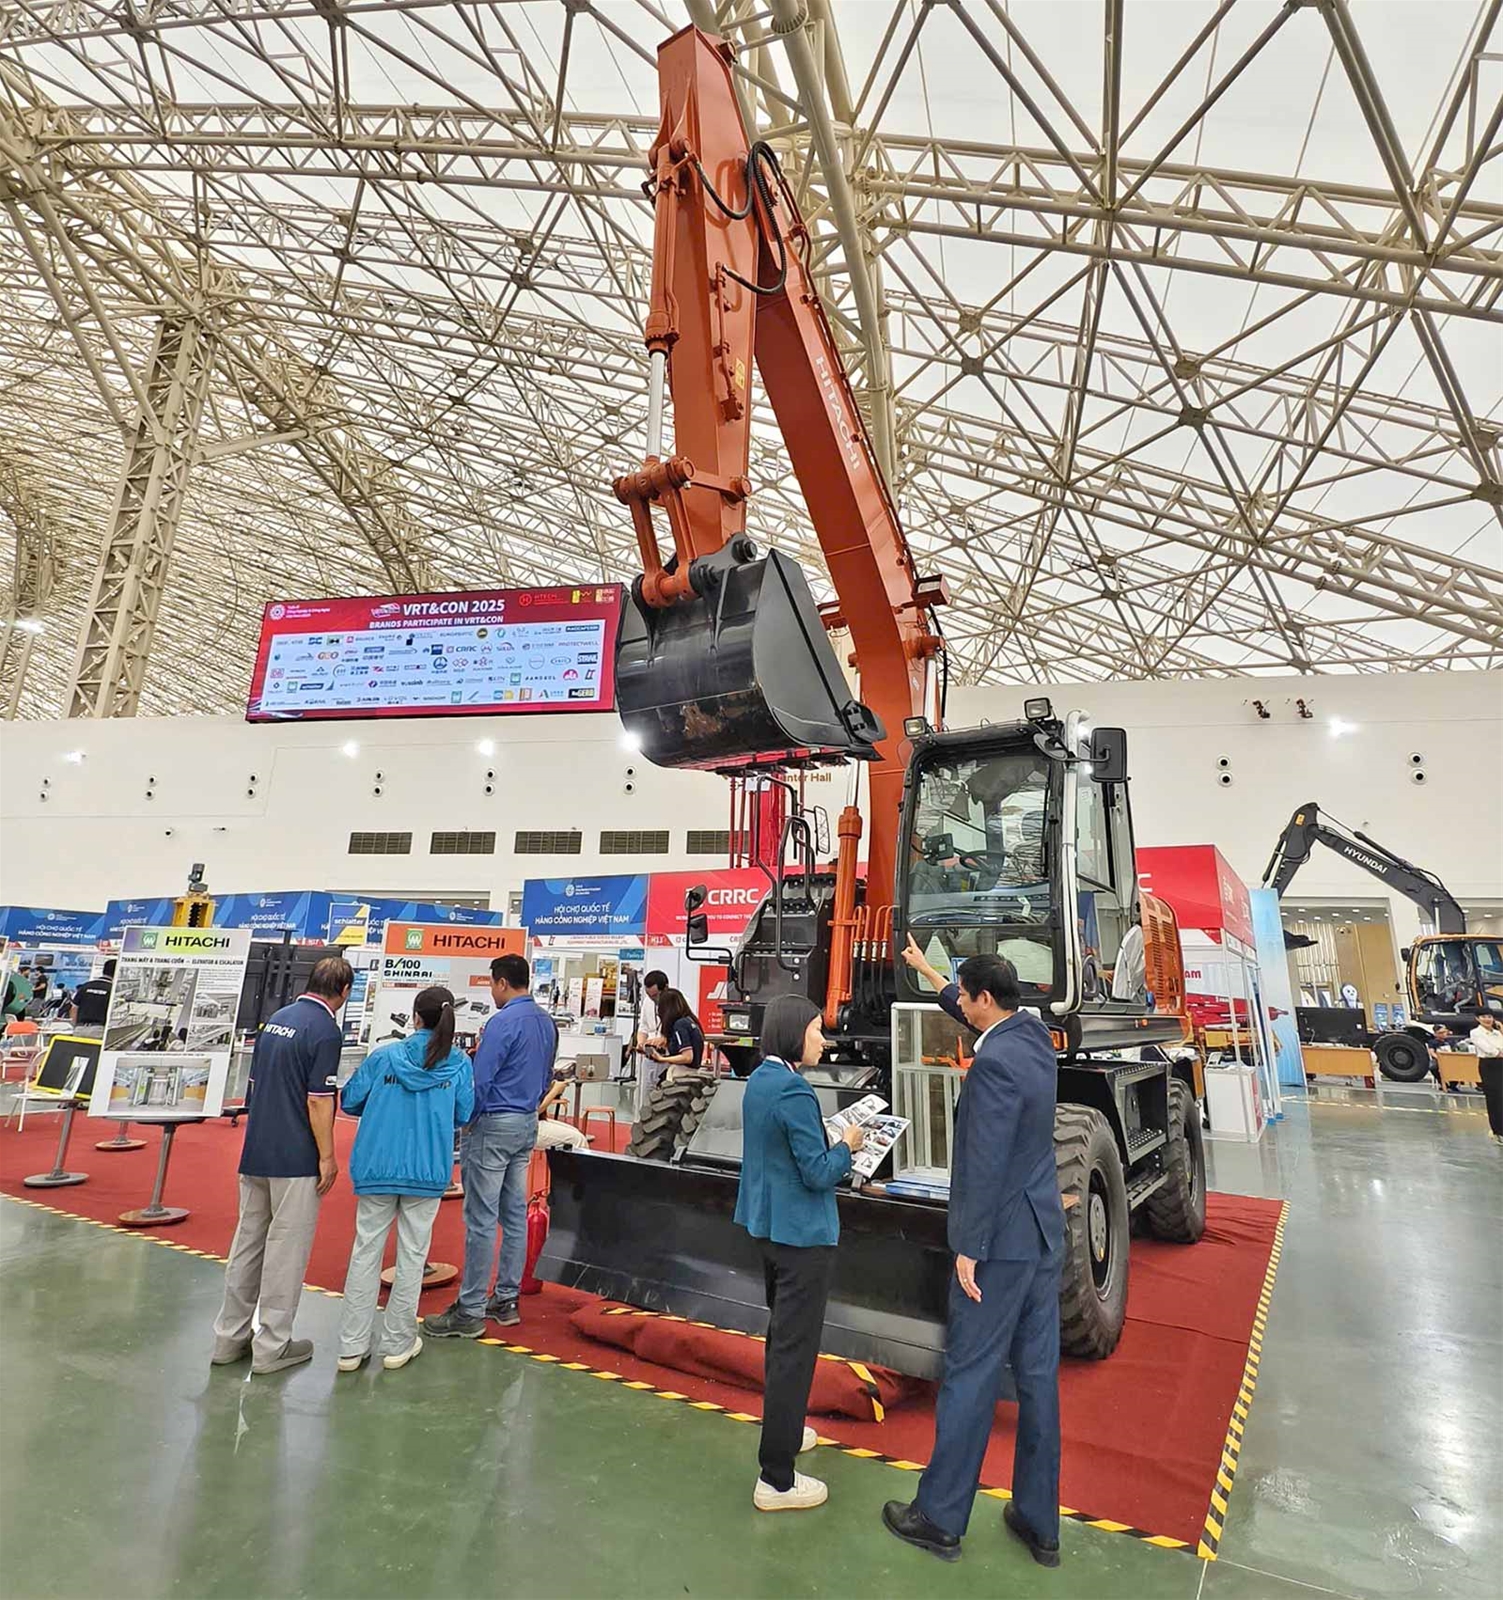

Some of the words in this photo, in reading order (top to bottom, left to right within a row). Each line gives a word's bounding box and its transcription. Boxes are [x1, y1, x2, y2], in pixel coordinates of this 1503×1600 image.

[815, 356, 861, 470] HITACHI
[402, 601, 469, 617] VRT&CON
[471, 599, 506, 614] 2025
[369, 619, 402, 629] BRANDS
[403, 617, 453, 628] PARTICIPATE
[454, 616, 464, 625] IN
[464, 615, 504, 624] VRT&CON
[810, 773, 832, 782] Hall
[1343, 846, 1388, 874] HYUNDAI
[707, 888, 760, 905] CRRC
[334, 917, 364, 925] schlatter
[535, 915, 553, 925] HÀNG
[573, 914, 598, 926] NGHIỆP
[598, 914, 613, 926] VIỆT
[613, 914, 630, 923] NAM
[164, 936, 231, 948] HITACHI
[433, 934, 506, 949] HITACHI
[385, 958, 421, 969] B/100
[384, 970, 433, 978] SHINRAI
[263, 1023, 297, 1039] HITACHI
